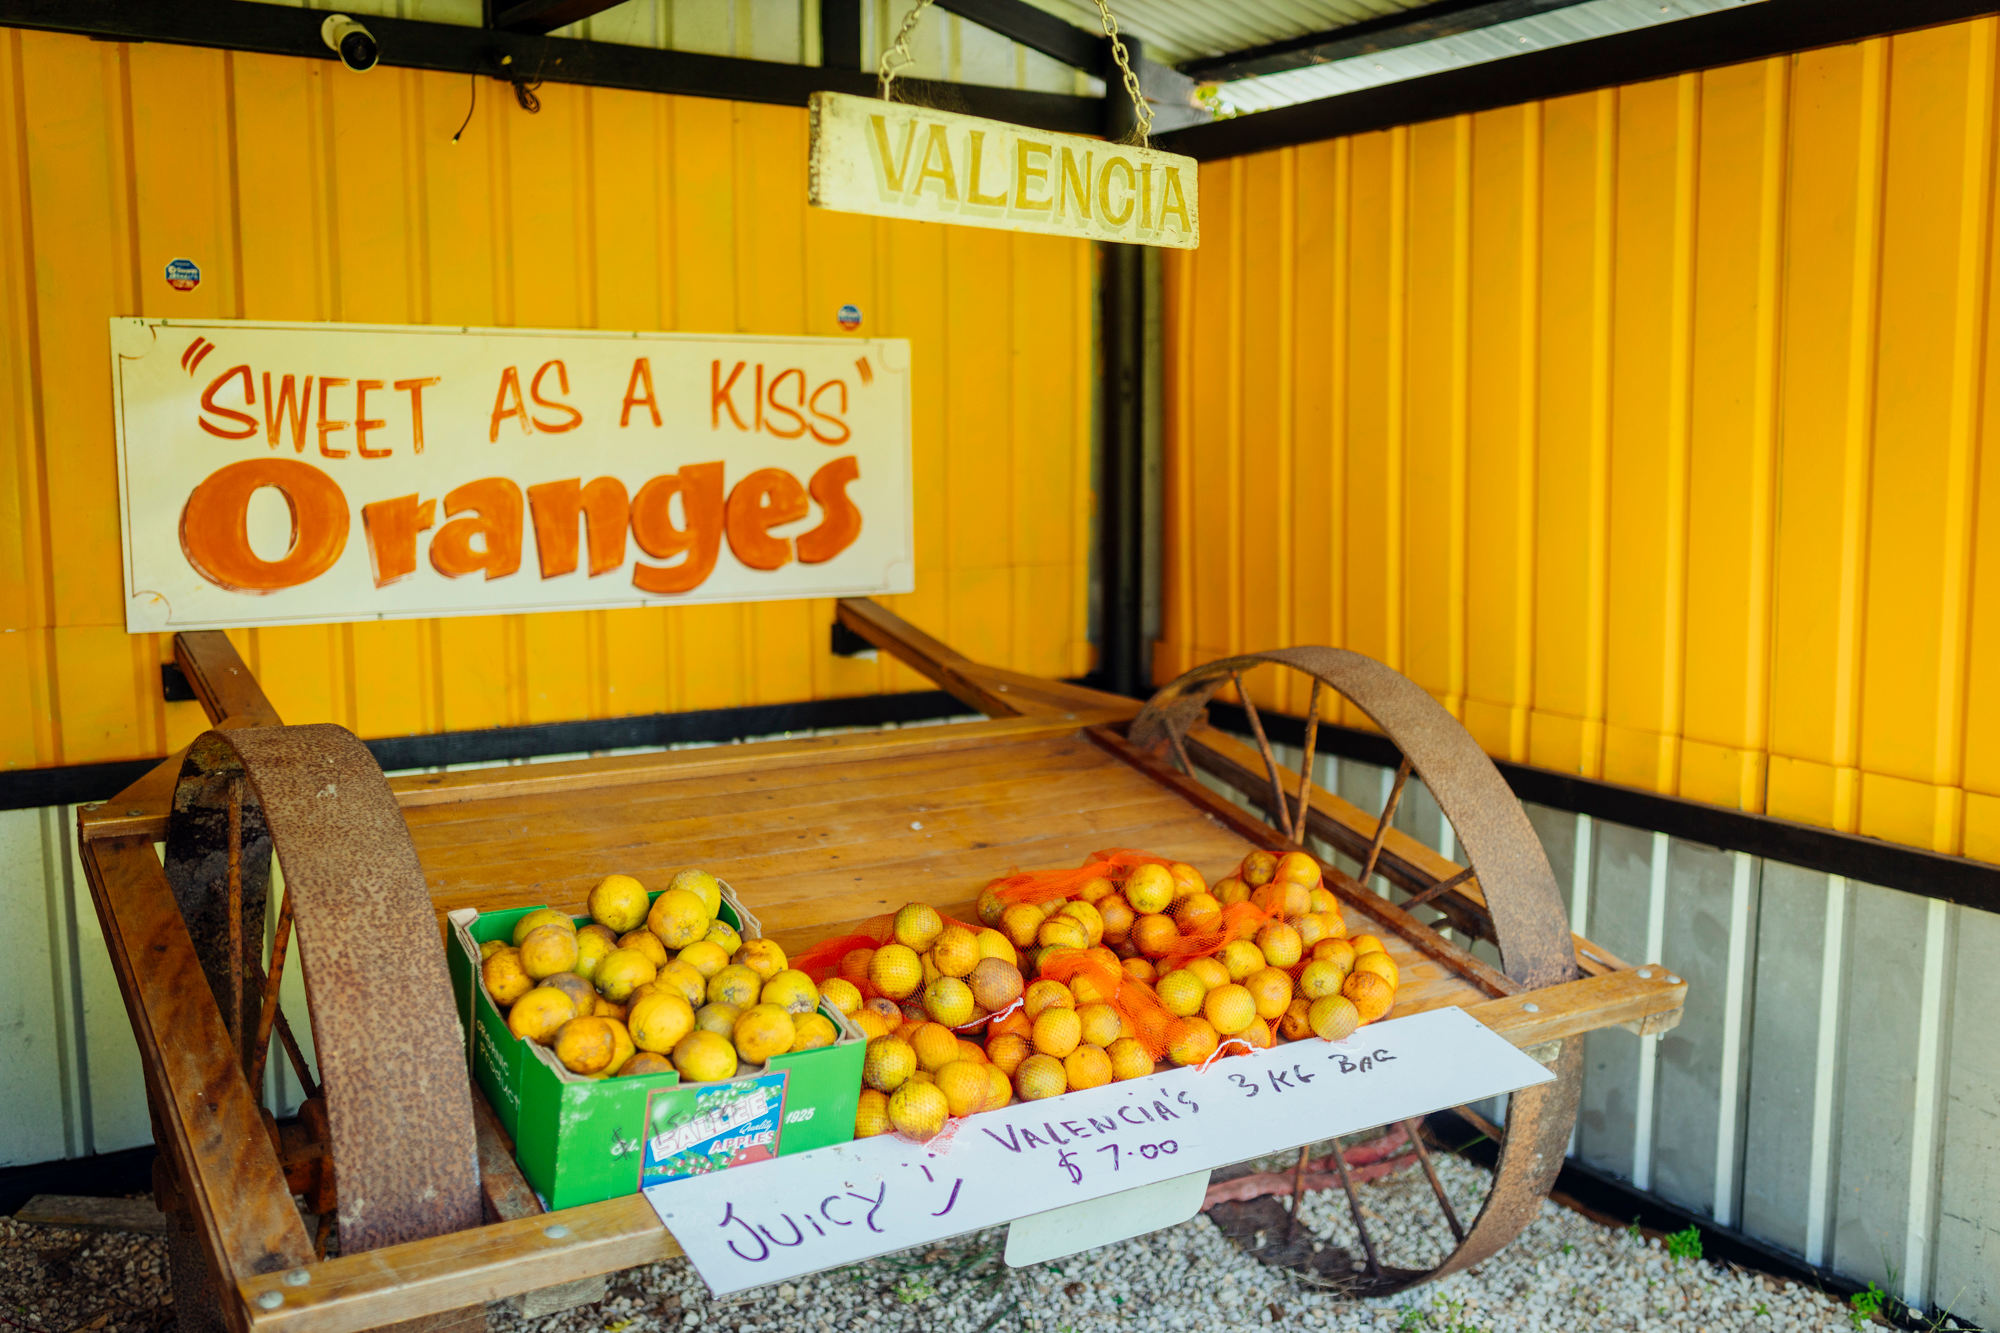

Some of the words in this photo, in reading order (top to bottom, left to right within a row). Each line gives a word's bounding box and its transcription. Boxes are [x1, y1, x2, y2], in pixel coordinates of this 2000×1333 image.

[866, 114, 1193, 236] VALENCIA
[490, 359, 583, 444] AS
[620, 357, 662, 428] A
[178, 456, 863, 596] Oranges
[708, 1130, 775, 1155] APPLES
[739, 1118, 774, 1134] Quality
[785, 1107, 816, 1125] 1925
[981, 1087, 1199, 1153] VALENCIA'S
[1327, 1049, 1398, 1074] BAG
[718, 1180, 886, 1262] JUICY
